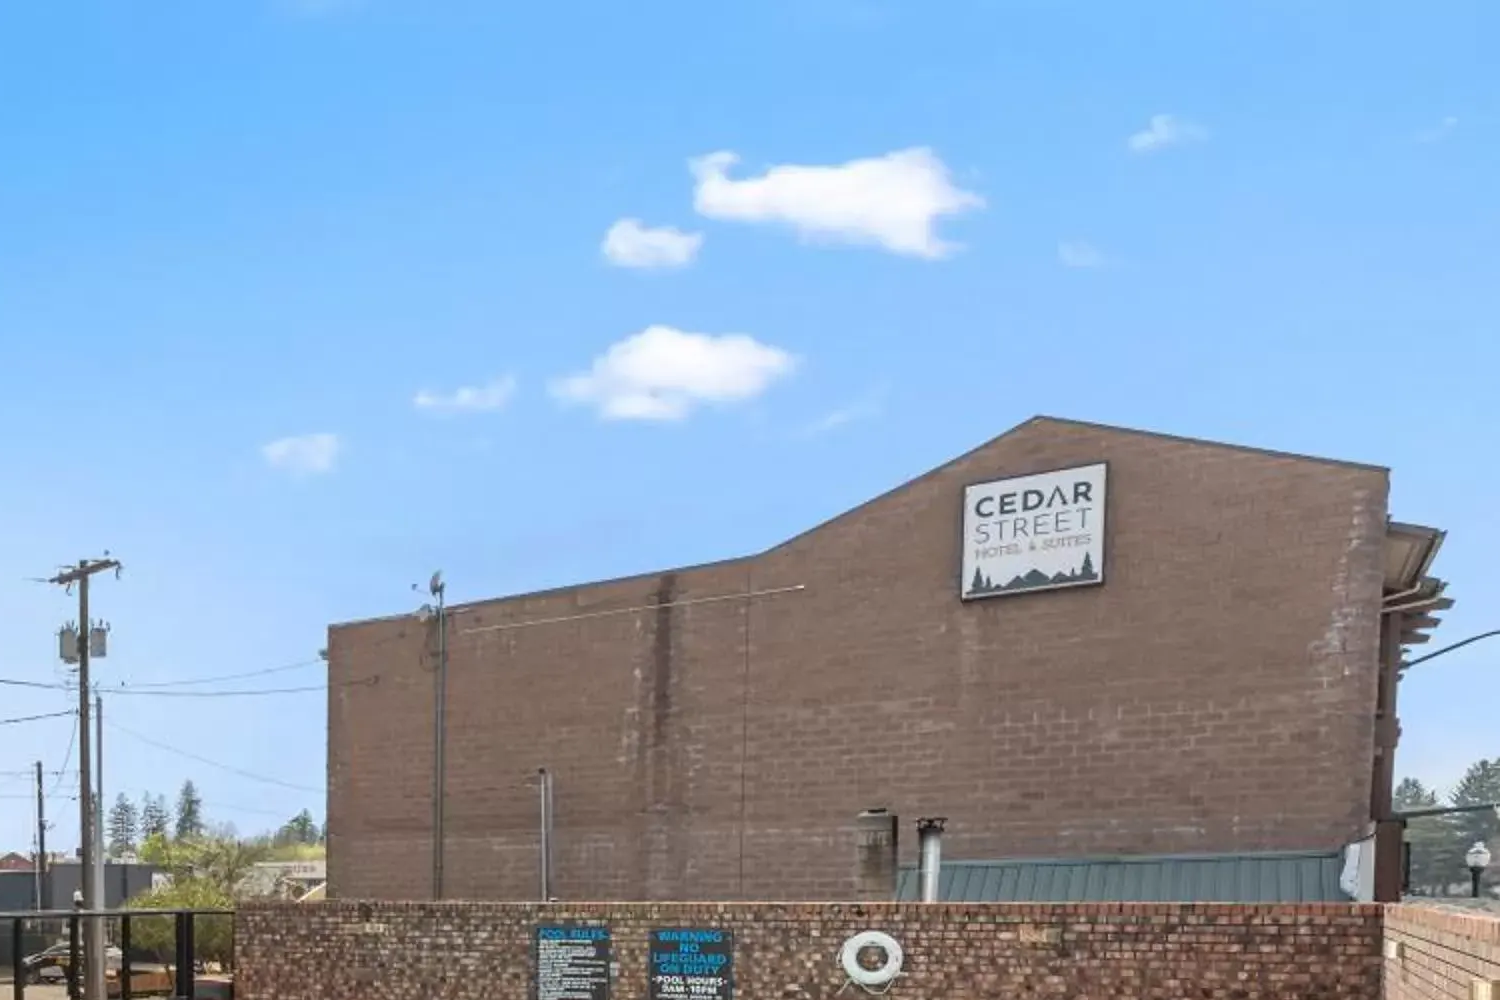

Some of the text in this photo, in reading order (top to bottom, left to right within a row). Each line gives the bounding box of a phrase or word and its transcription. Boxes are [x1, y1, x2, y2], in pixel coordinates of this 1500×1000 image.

[975, 481, 1092, 518] CEDAR
[974, 507, 1092, 545] STREET
[1041, 533, 1091, 550] SUITES
[657, 930, 723, 943] WARNING
[679, 943, 700, 953] NO
[653, 952, 727, 965] LIFEGUARD
[683, 964, 720, 976] DUTY
